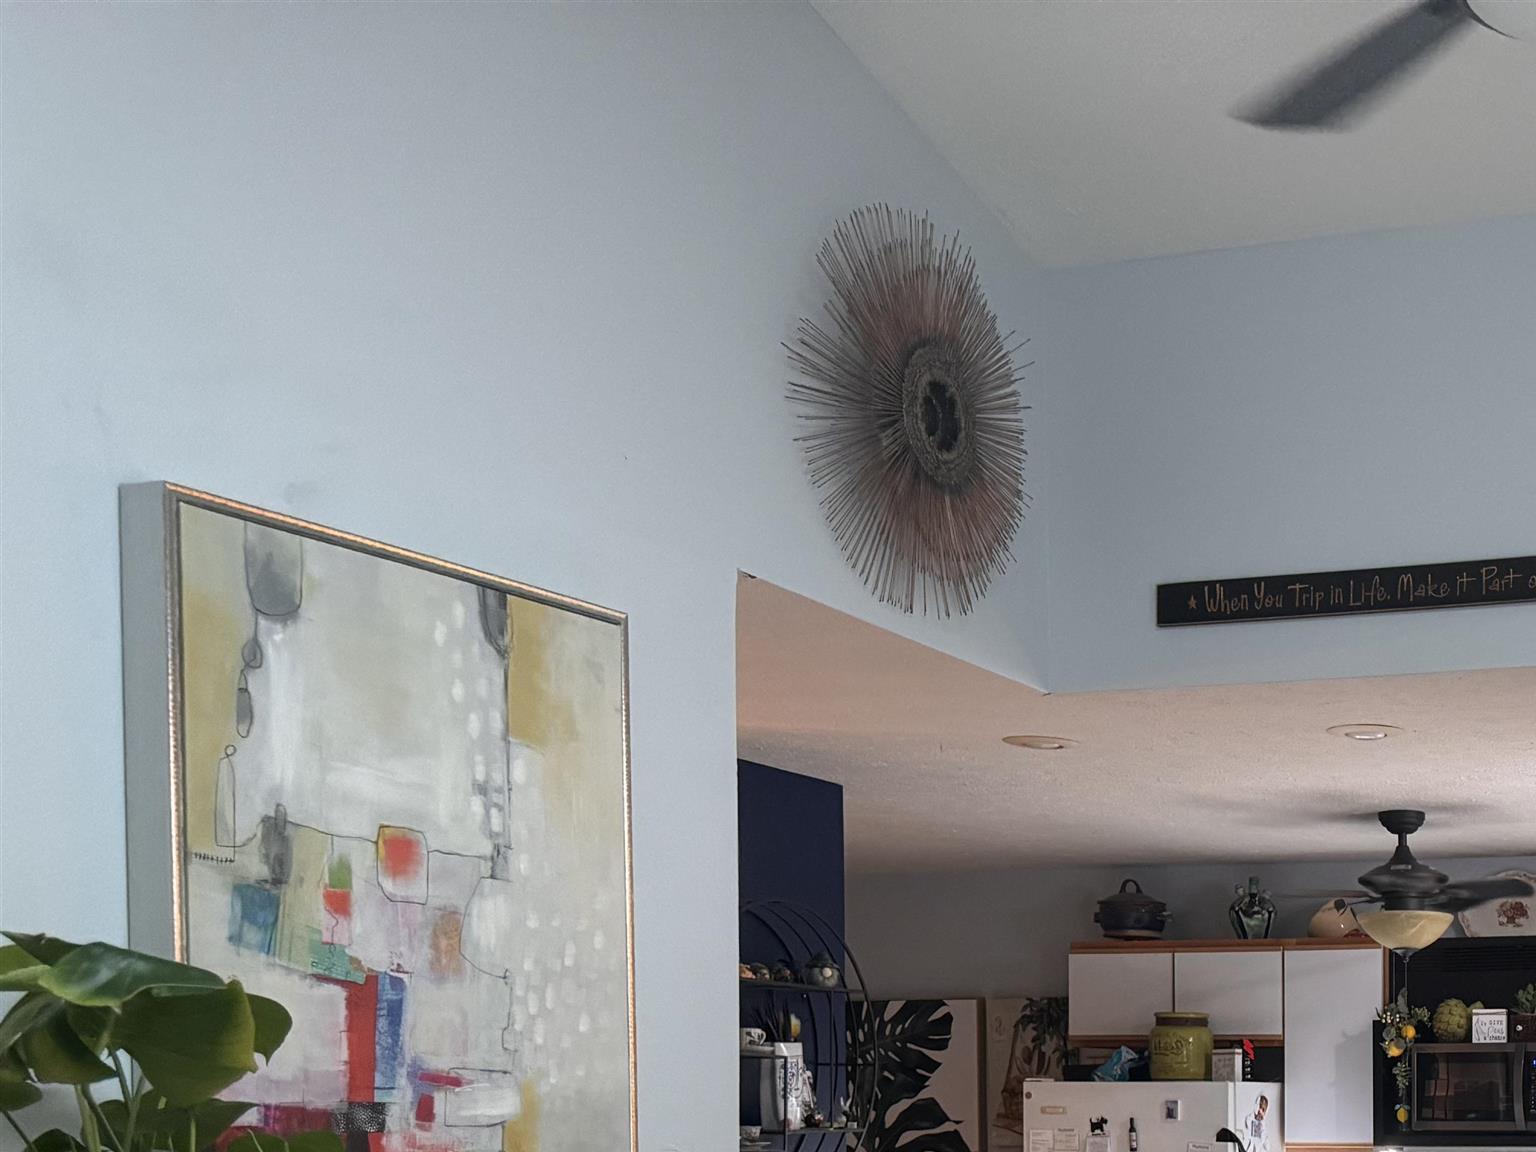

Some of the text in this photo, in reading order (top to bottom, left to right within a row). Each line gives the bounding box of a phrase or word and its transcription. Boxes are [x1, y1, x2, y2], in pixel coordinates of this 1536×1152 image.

[1204, 583, 1249, 615] When
[1254, 581, 1284, 611] You
[1287, 584, 1325, 611] Trip
[1330, 584, 1345, 606] in
[1397, 572, 1450, 602] Make
[1456, 572, 1477, 597] it
[1480, 565, 1523, 595] Part
